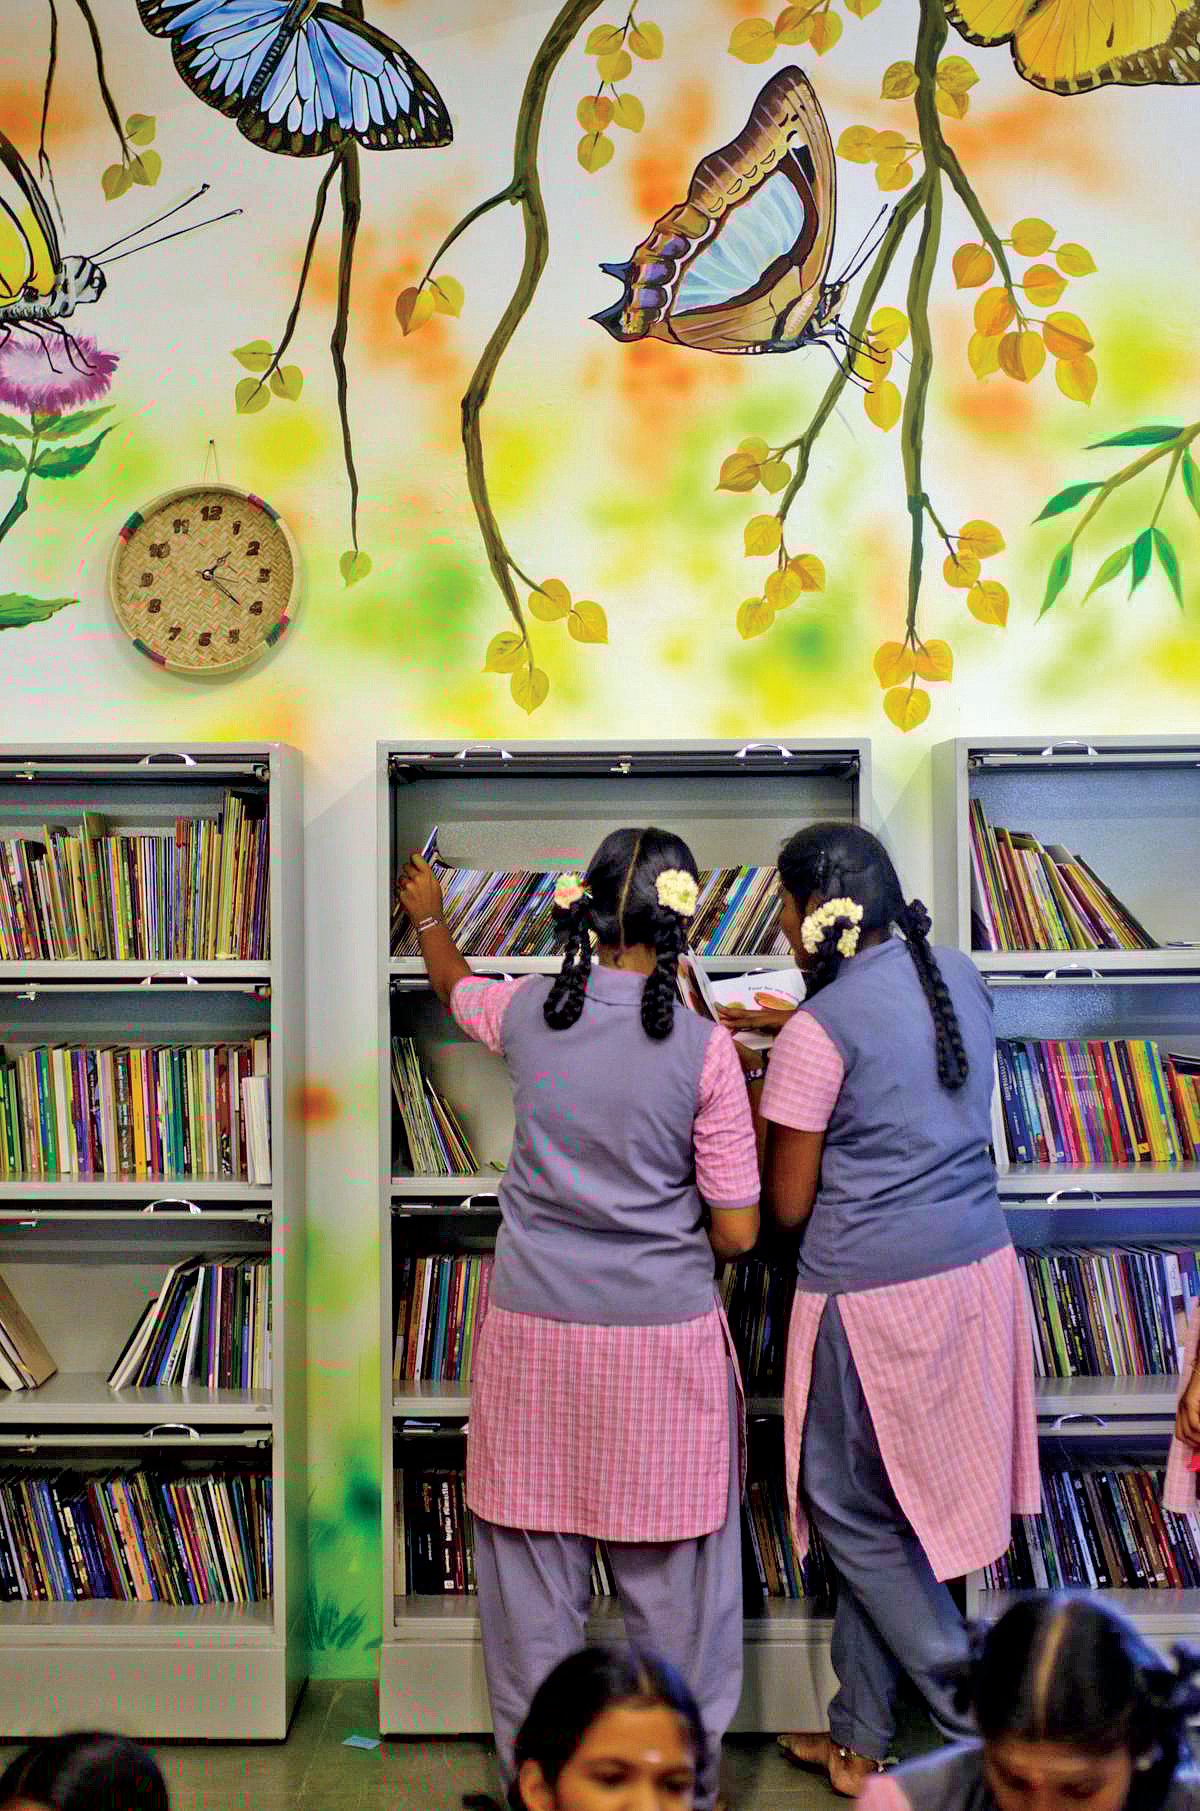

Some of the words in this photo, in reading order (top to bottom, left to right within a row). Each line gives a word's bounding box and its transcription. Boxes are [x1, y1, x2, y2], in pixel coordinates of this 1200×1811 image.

[201, 505, 223, 521] 12
[232, 520, 242, 535] 1
[246, 541, 260, 556] 2
[148, 598, 161, 614] 8
[249, 600, 263, 616] 4
[168, 626, 182, 641] 7
[198, 632, 213, 647] 6
